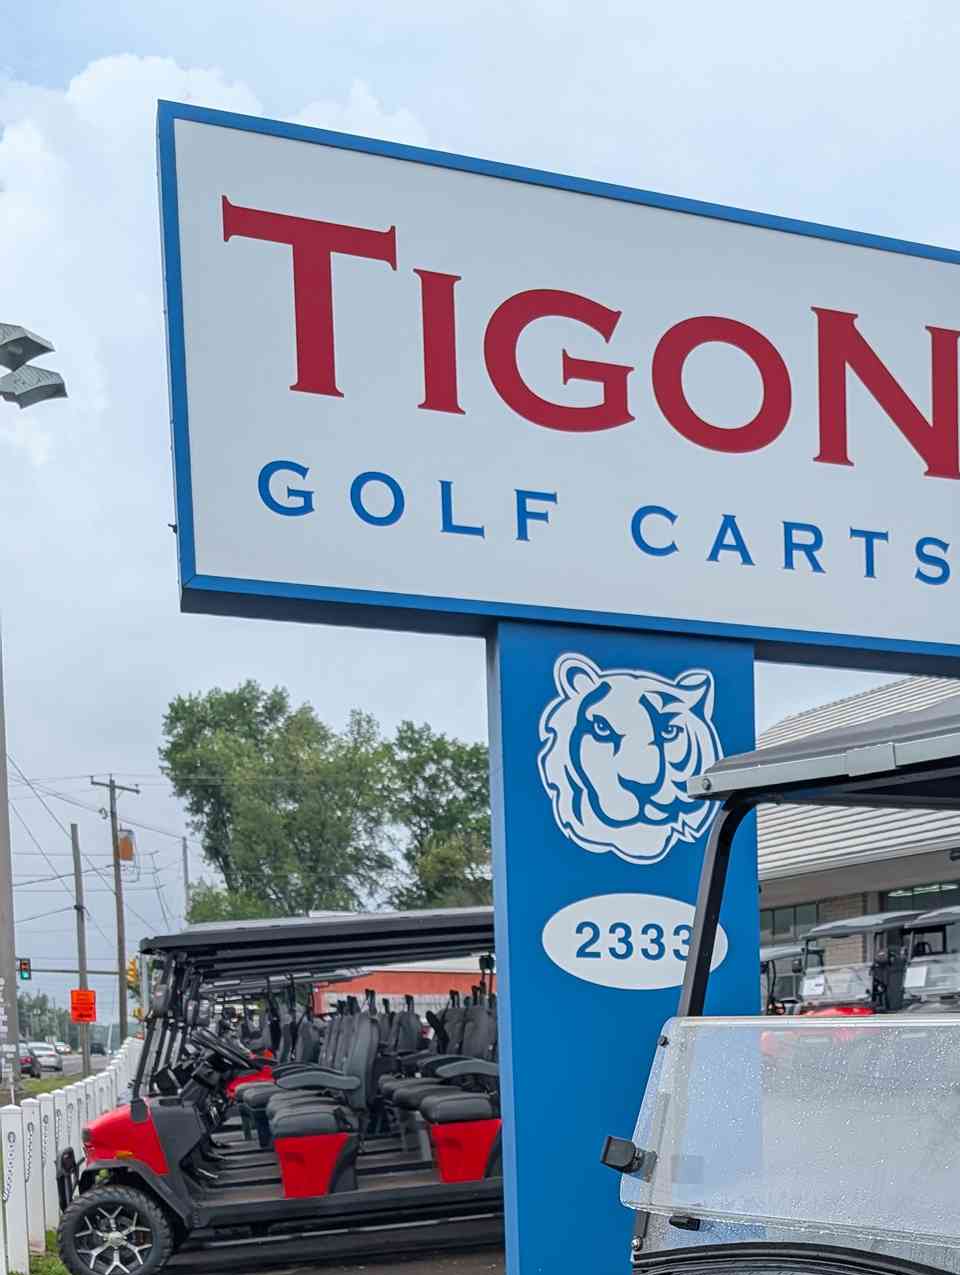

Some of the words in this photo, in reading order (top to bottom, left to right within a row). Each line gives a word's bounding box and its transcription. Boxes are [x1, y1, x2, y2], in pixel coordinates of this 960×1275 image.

[257, 459, 557, 542] GOLF
[629, 504, 952, 586] CARTS
[575, 920, 694, 962] 2333
